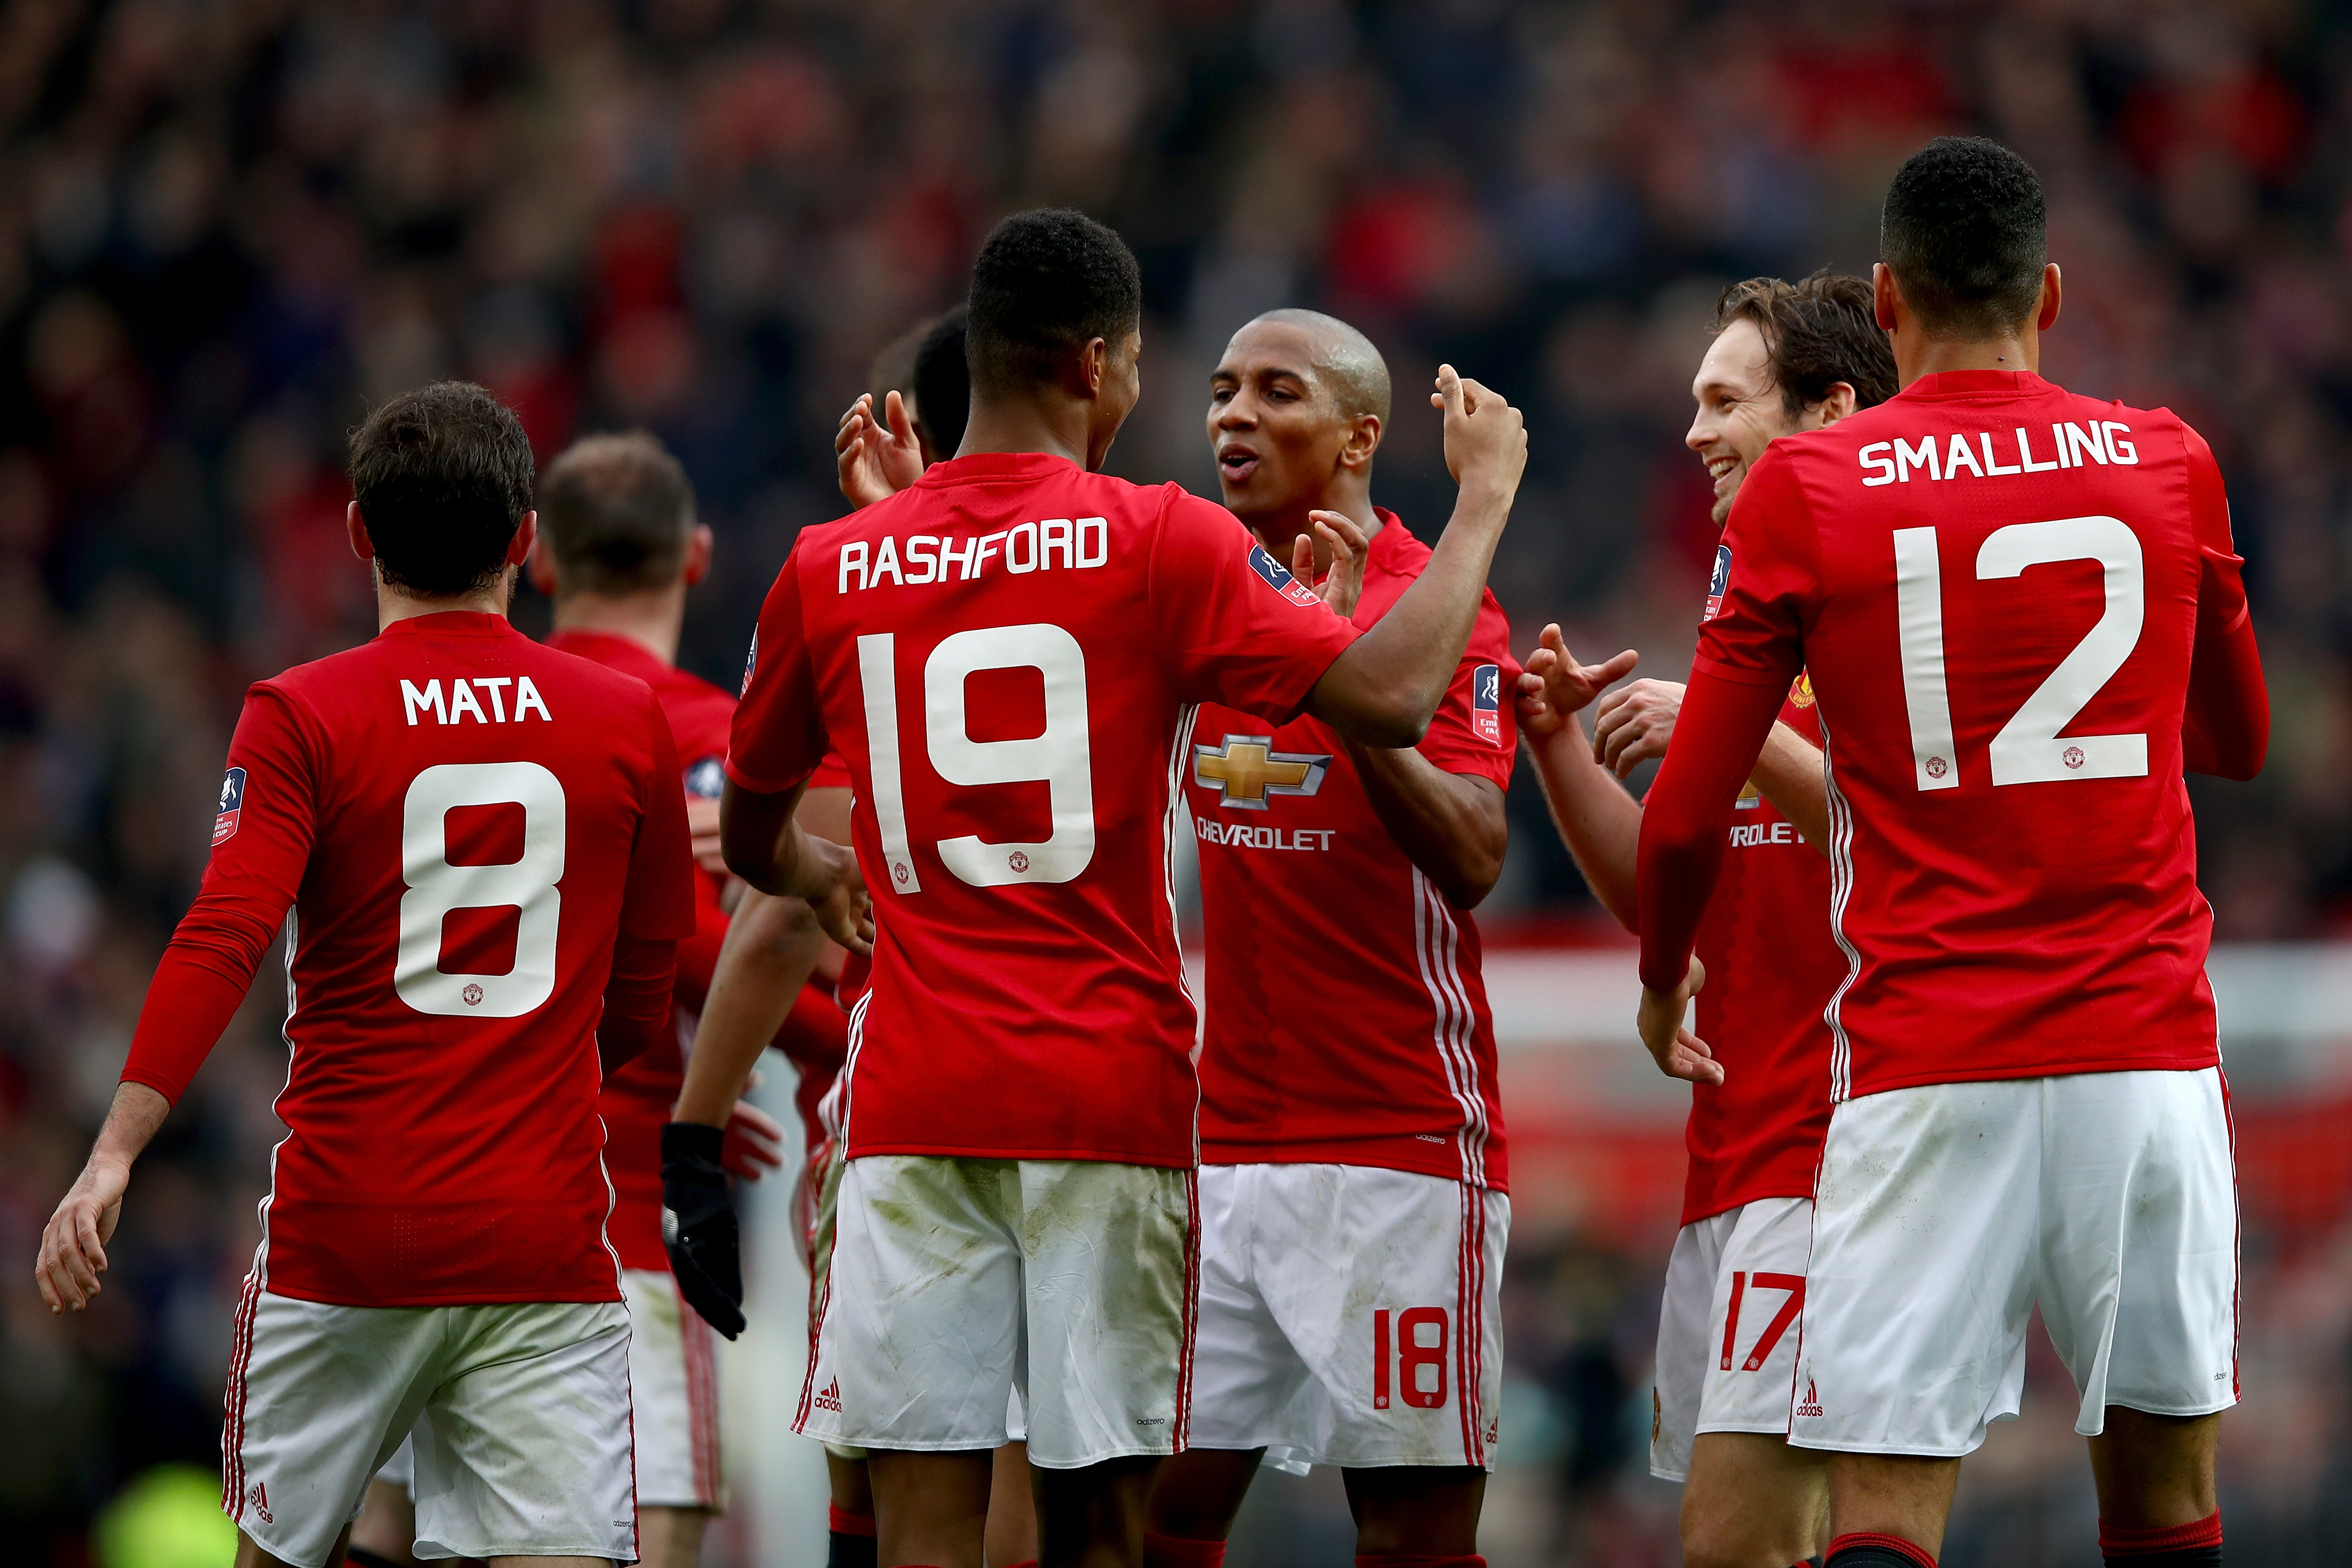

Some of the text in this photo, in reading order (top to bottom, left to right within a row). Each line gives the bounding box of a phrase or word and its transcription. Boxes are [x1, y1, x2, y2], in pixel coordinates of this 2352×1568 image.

[1858, 420, 2139, 487] SMALLING
[838, 516, 1108, 594] RASHFORD
[1892, 515, 2149, 791] 12
[399, 676, 553, 726] MATA
[857, 623, 1095, 894] 19
[1197, 816, 1336, 851] CHEVROLET
[1729, 822, 1806, 847] ROLE
[394, 761, 566, 1018] 8
[1374, 1307, 1448, 1409] 18
[1720, 1271, 1807, 1371] 17
